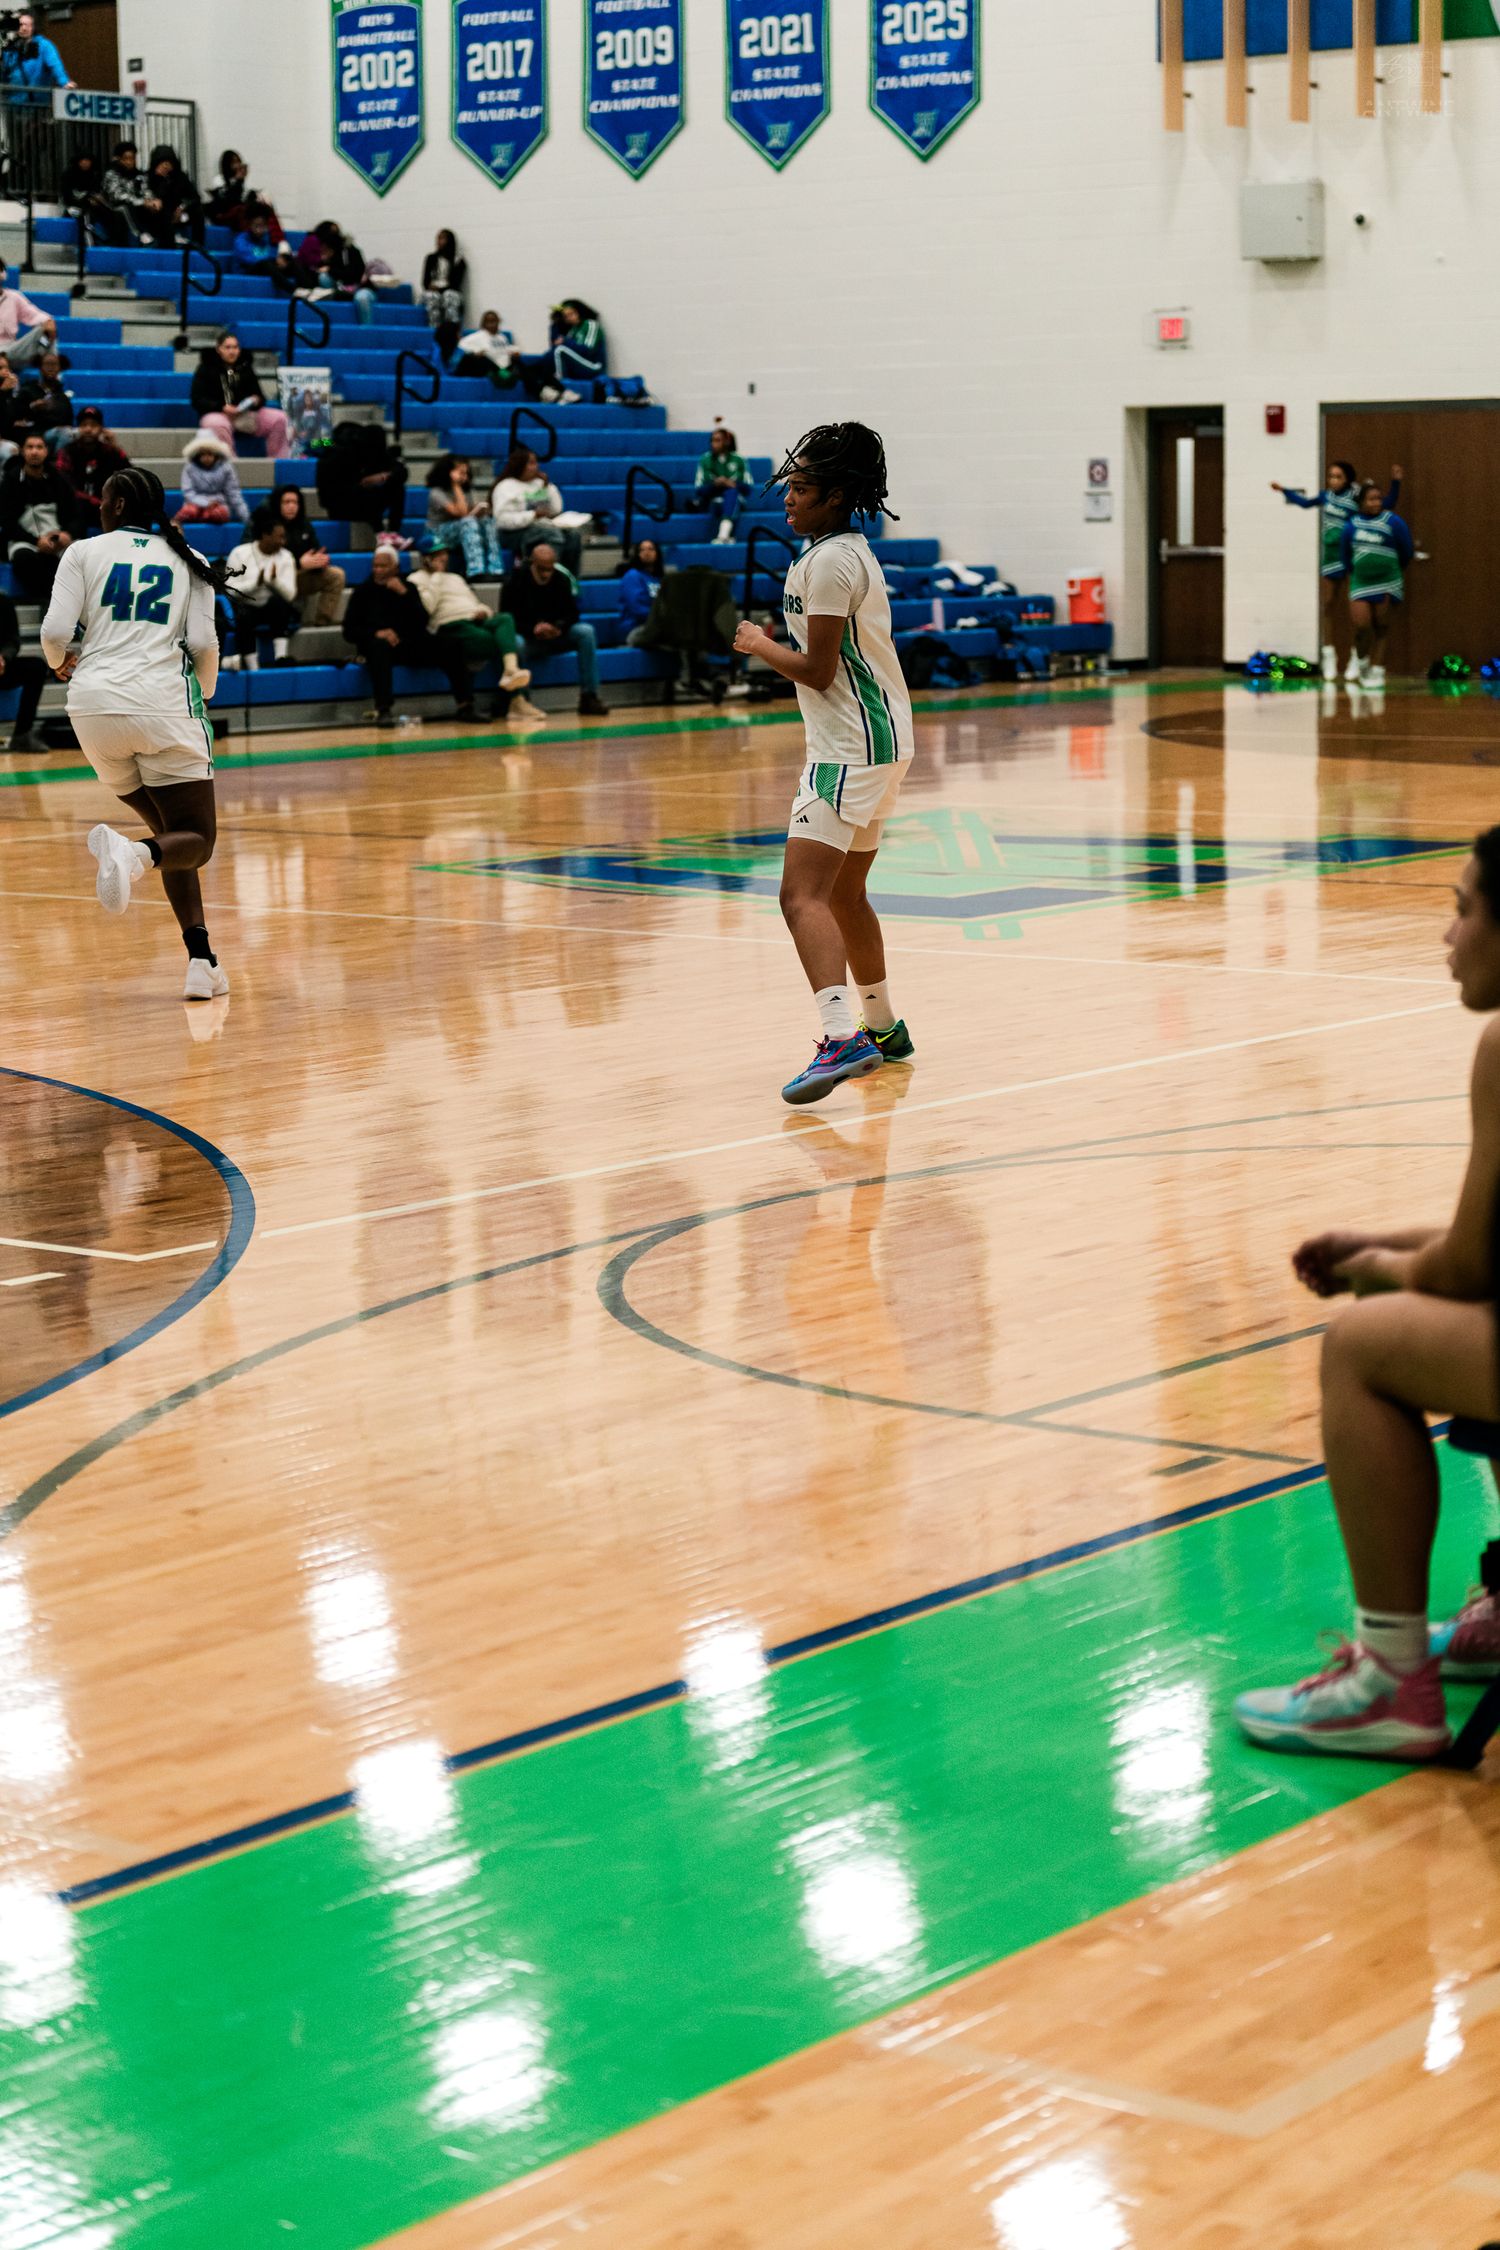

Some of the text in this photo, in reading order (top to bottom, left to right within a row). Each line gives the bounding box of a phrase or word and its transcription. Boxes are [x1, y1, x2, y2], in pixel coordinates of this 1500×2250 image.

[462, 10, 534, 26] FOOTBALL
[882, 0, 968, 44] 2025
[336, 29, 416, 48] BASKETBALL
[739, 13, 815, 58] 2021
[596, 25, 674, 71] 2009
[466, 39, 534, 82] 2017
[899, 52, 949, 69] STATE
[342, 49, 414, 92] 2002
[752, 65, 801, 82] STATE
[875, 70, 974, 90] CHAMPIONS
[611, 77, 657, 93] STATE
[731, 82, 823, 102] CHAMPIONS
[477, 88, 521, 104] STATE
[588, 94, 680, 113] CHAMPIONS
[65, 93, 135, 121] CHEER
[358, 98, 398, 114] STATE
[457, 105, 544, 123] RUNNER-UP
[338, 114, 419, 133] RUNNER-UP
[101, 562, 174, 625] 42
